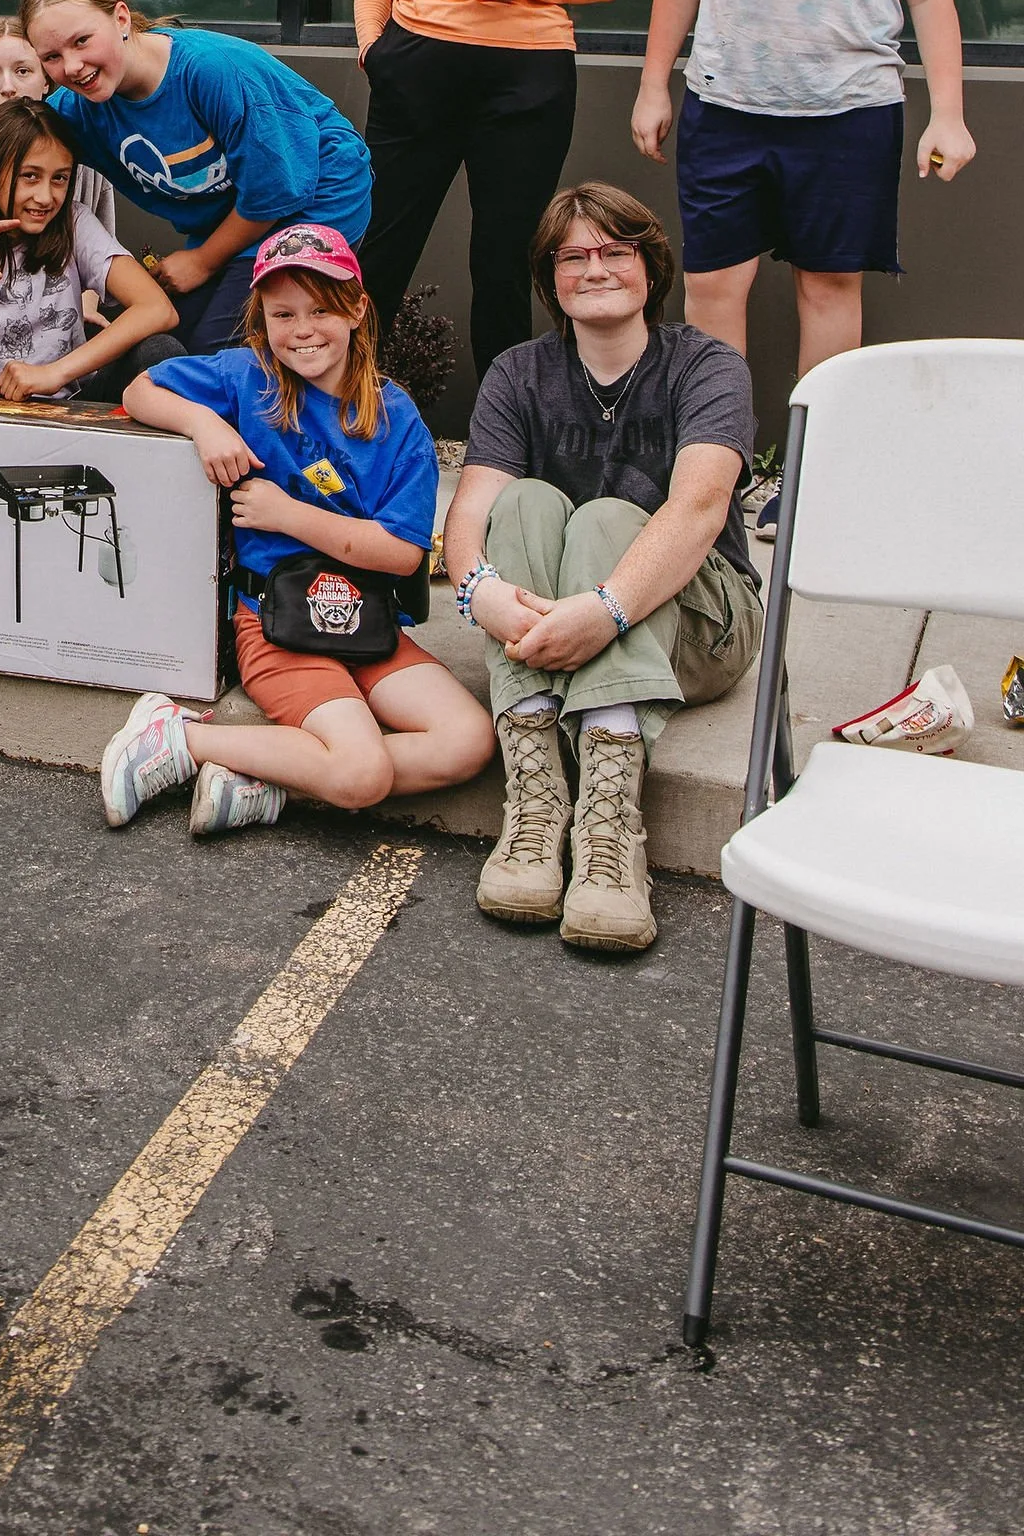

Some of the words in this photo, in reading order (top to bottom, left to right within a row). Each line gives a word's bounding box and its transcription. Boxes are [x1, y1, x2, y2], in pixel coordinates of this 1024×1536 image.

[318, 581, 335, 591] FISH
[336, 582, 350, 592] FOR
[316, 591, 352, 602] GARBAGE
